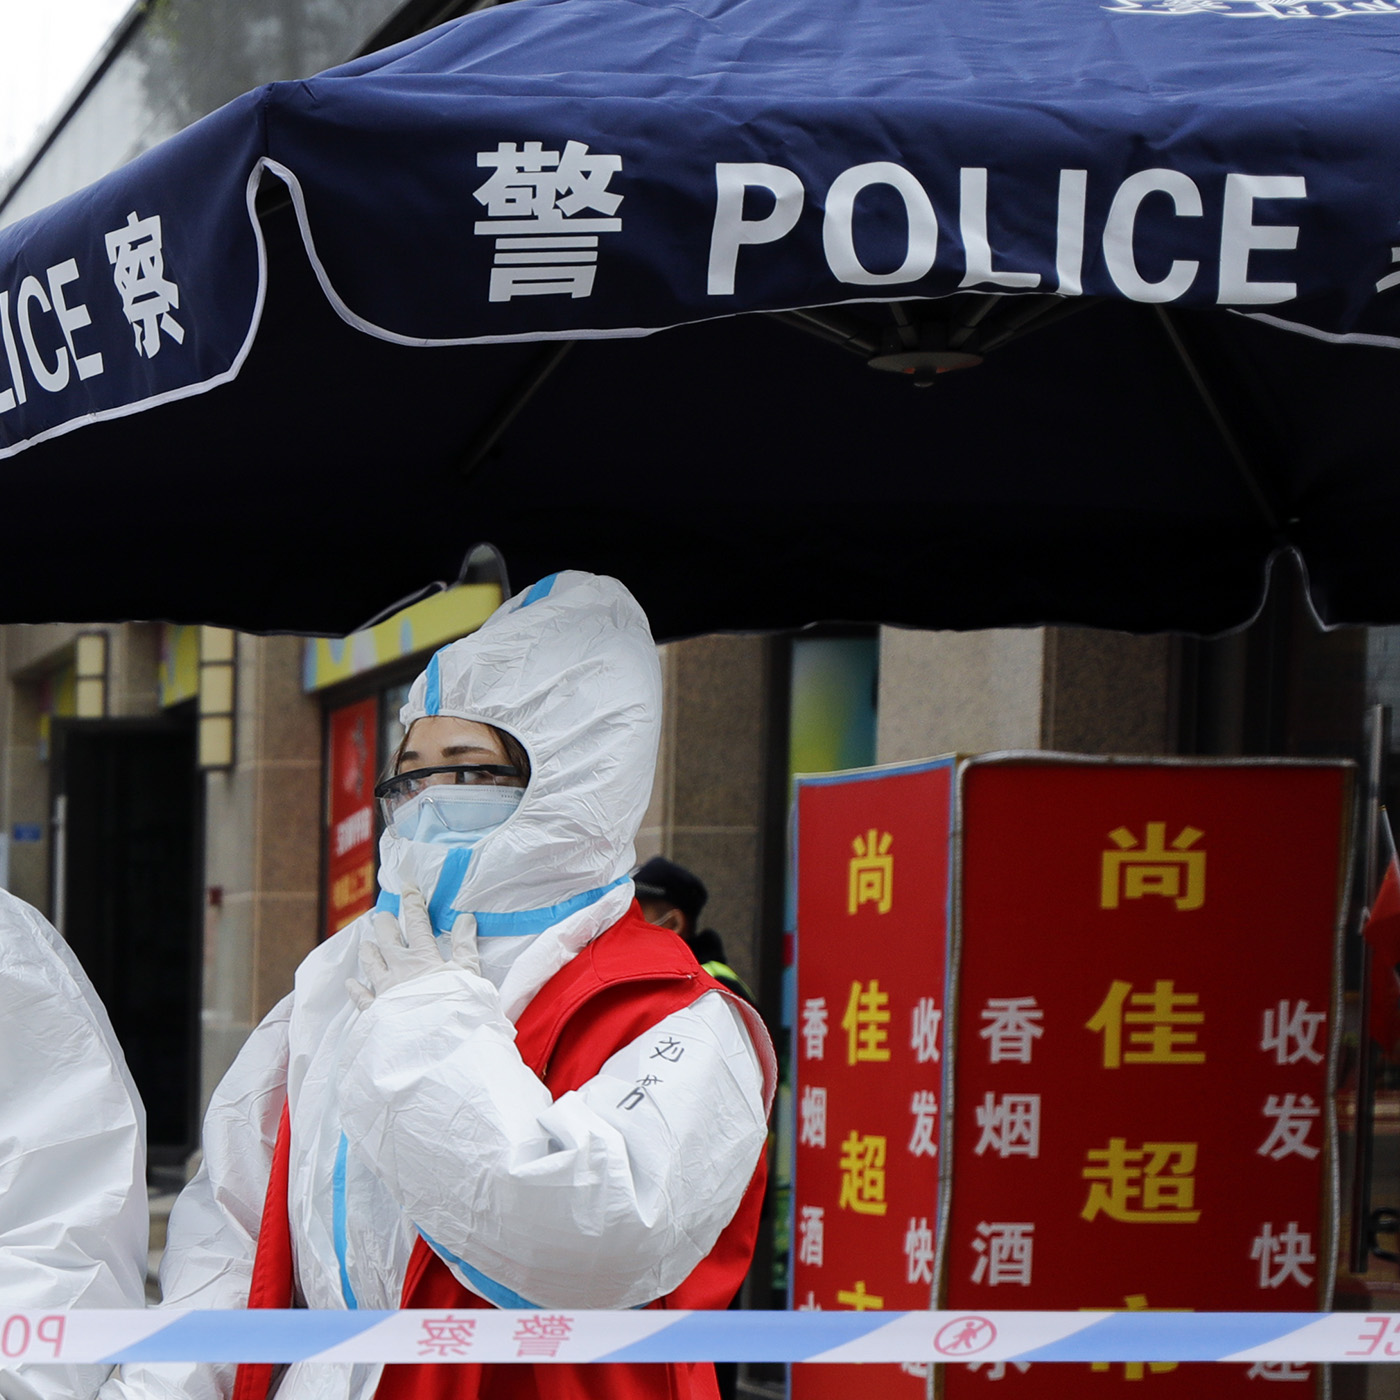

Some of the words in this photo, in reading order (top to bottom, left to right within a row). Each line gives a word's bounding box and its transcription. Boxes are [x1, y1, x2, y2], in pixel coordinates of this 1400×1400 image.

[104, 211, 185, 359] 察
[473, 139, 624, 302] 警
[707, 161, 1307, 305] POLICE
